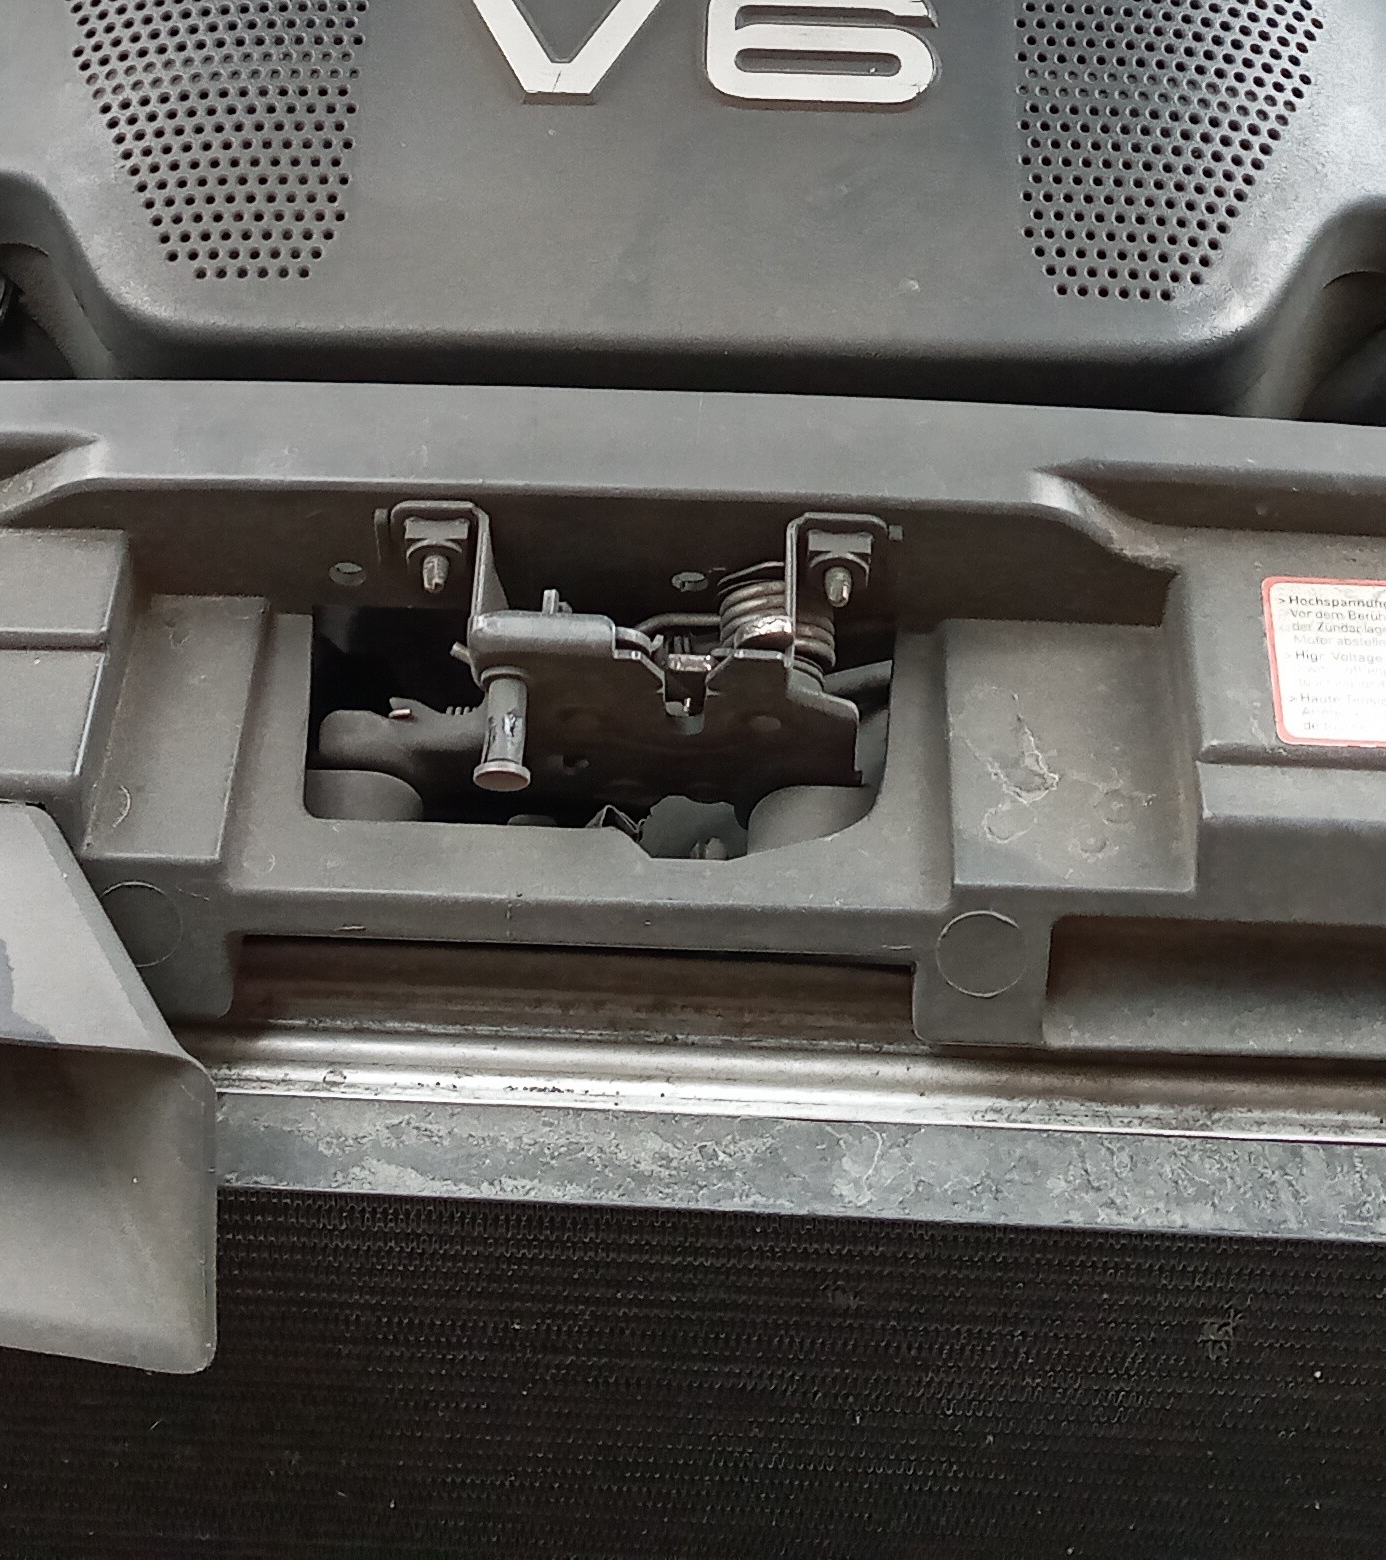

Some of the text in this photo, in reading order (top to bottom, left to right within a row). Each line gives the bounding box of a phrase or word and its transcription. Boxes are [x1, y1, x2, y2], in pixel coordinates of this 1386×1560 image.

[1290, 608, 1312, 618] Vor
[1315, 610, 1344, 620] dem
[1292, 621, 1312, 631] der
[1294, 634, 1333, 645] Motor
[1331, 651, 1383, 664] Voltage
